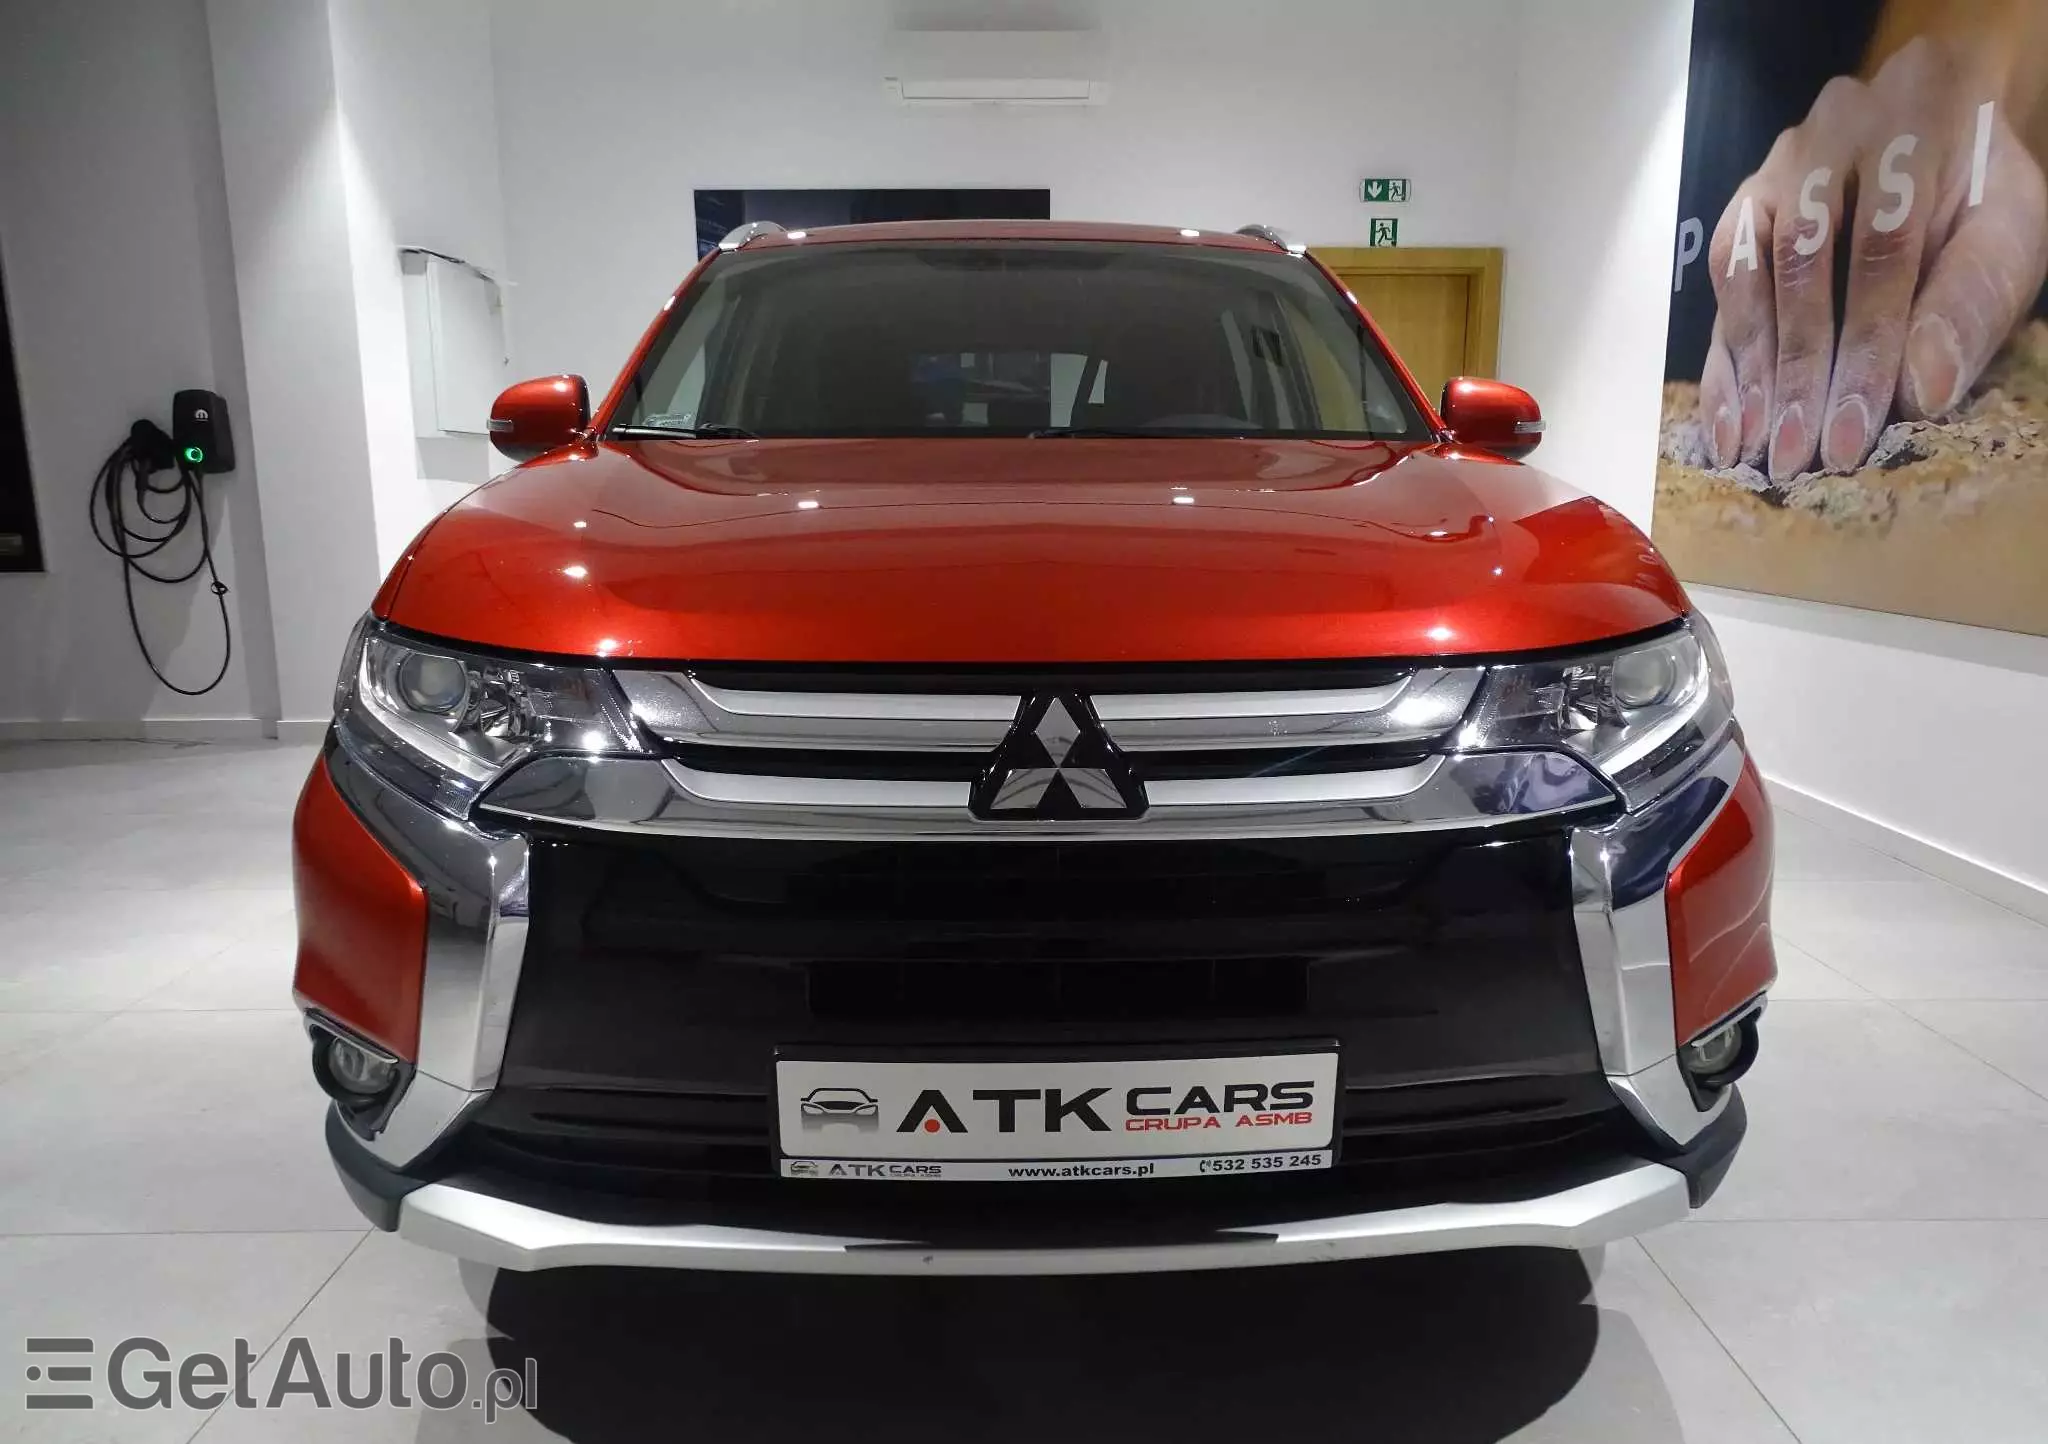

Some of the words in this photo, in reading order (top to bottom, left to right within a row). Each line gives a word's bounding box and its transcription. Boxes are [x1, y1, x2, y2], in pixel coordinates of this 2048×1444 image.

[896, 1088, 1113, 1133] ATK
[1125, 1081, 1315, 1115] CARS
[1125, 1116, 1221, 1131] GRUPA
[1235, 1111, 1313, 1128] ASMB
[829, 1163, 886, 1177] ATK
[889, 1165, 942, 1174] CARS
[1008, 1162, 1155, 1178] www.atkcars.pl
[1212, 1159, 1245, 1171] 532
[1251, 1156, 1283, 1169] 535
[1289, 1154, 1322, 1166] 245
